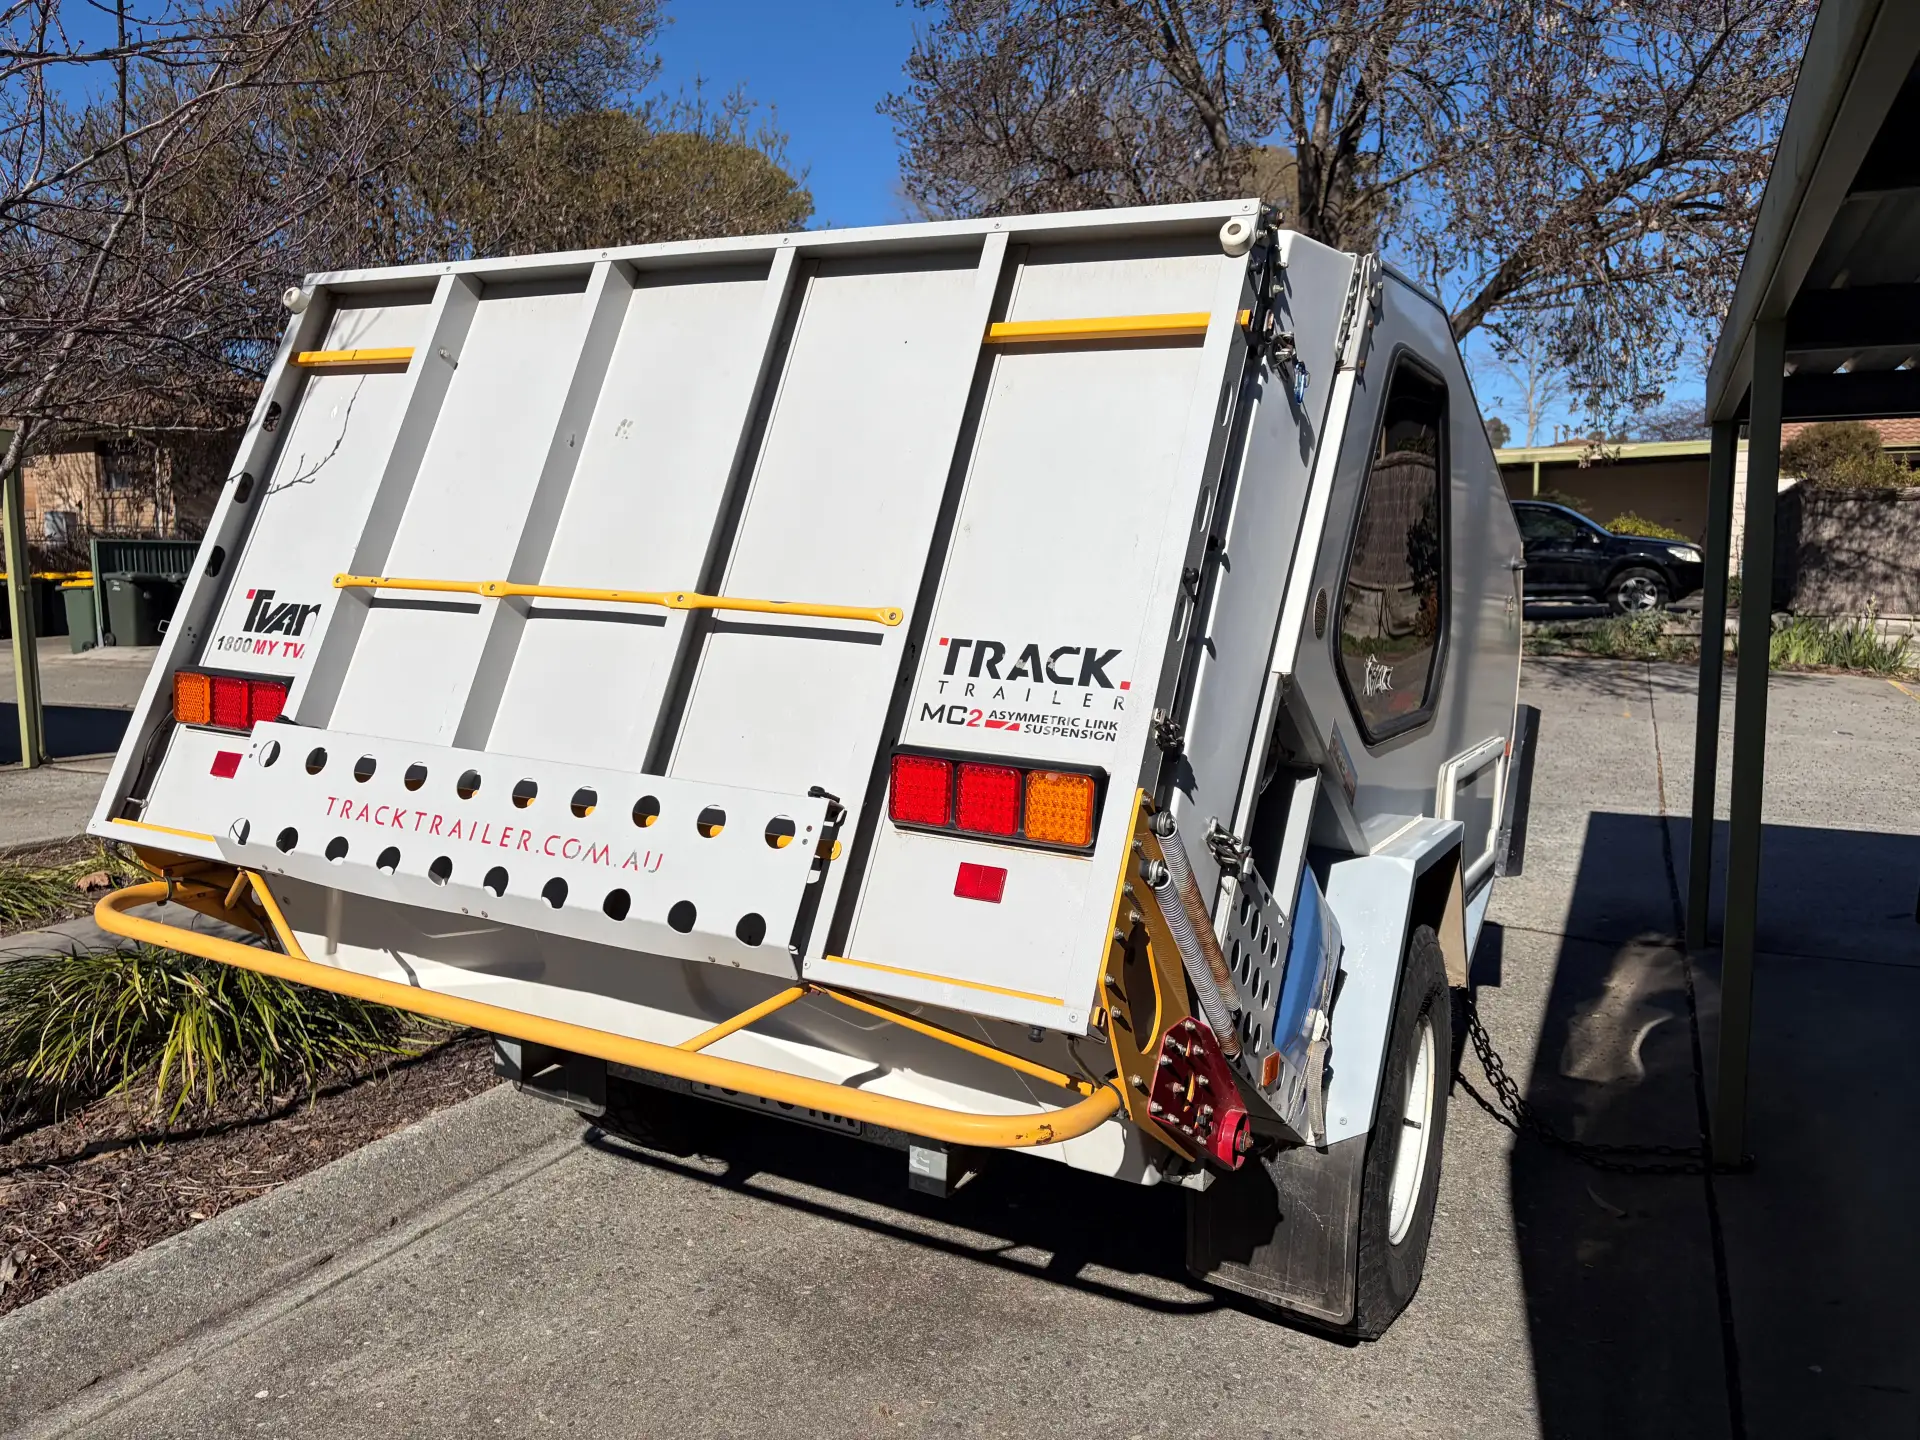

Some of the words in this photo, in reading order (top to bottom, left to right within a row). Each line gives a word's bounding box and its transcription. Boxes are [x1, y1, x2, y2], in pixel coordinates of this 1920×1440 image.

[283, 641, 305, 659] TV
[938, 680, 1126, 711] TRAILER
[920, 702, 984, 728] MC2
[988, 709, 1081, 729] ASYMMETRIC
[1084, 717, 1119, 732] LINK
[1023, 723, 1117, 742] SUSPENSION
